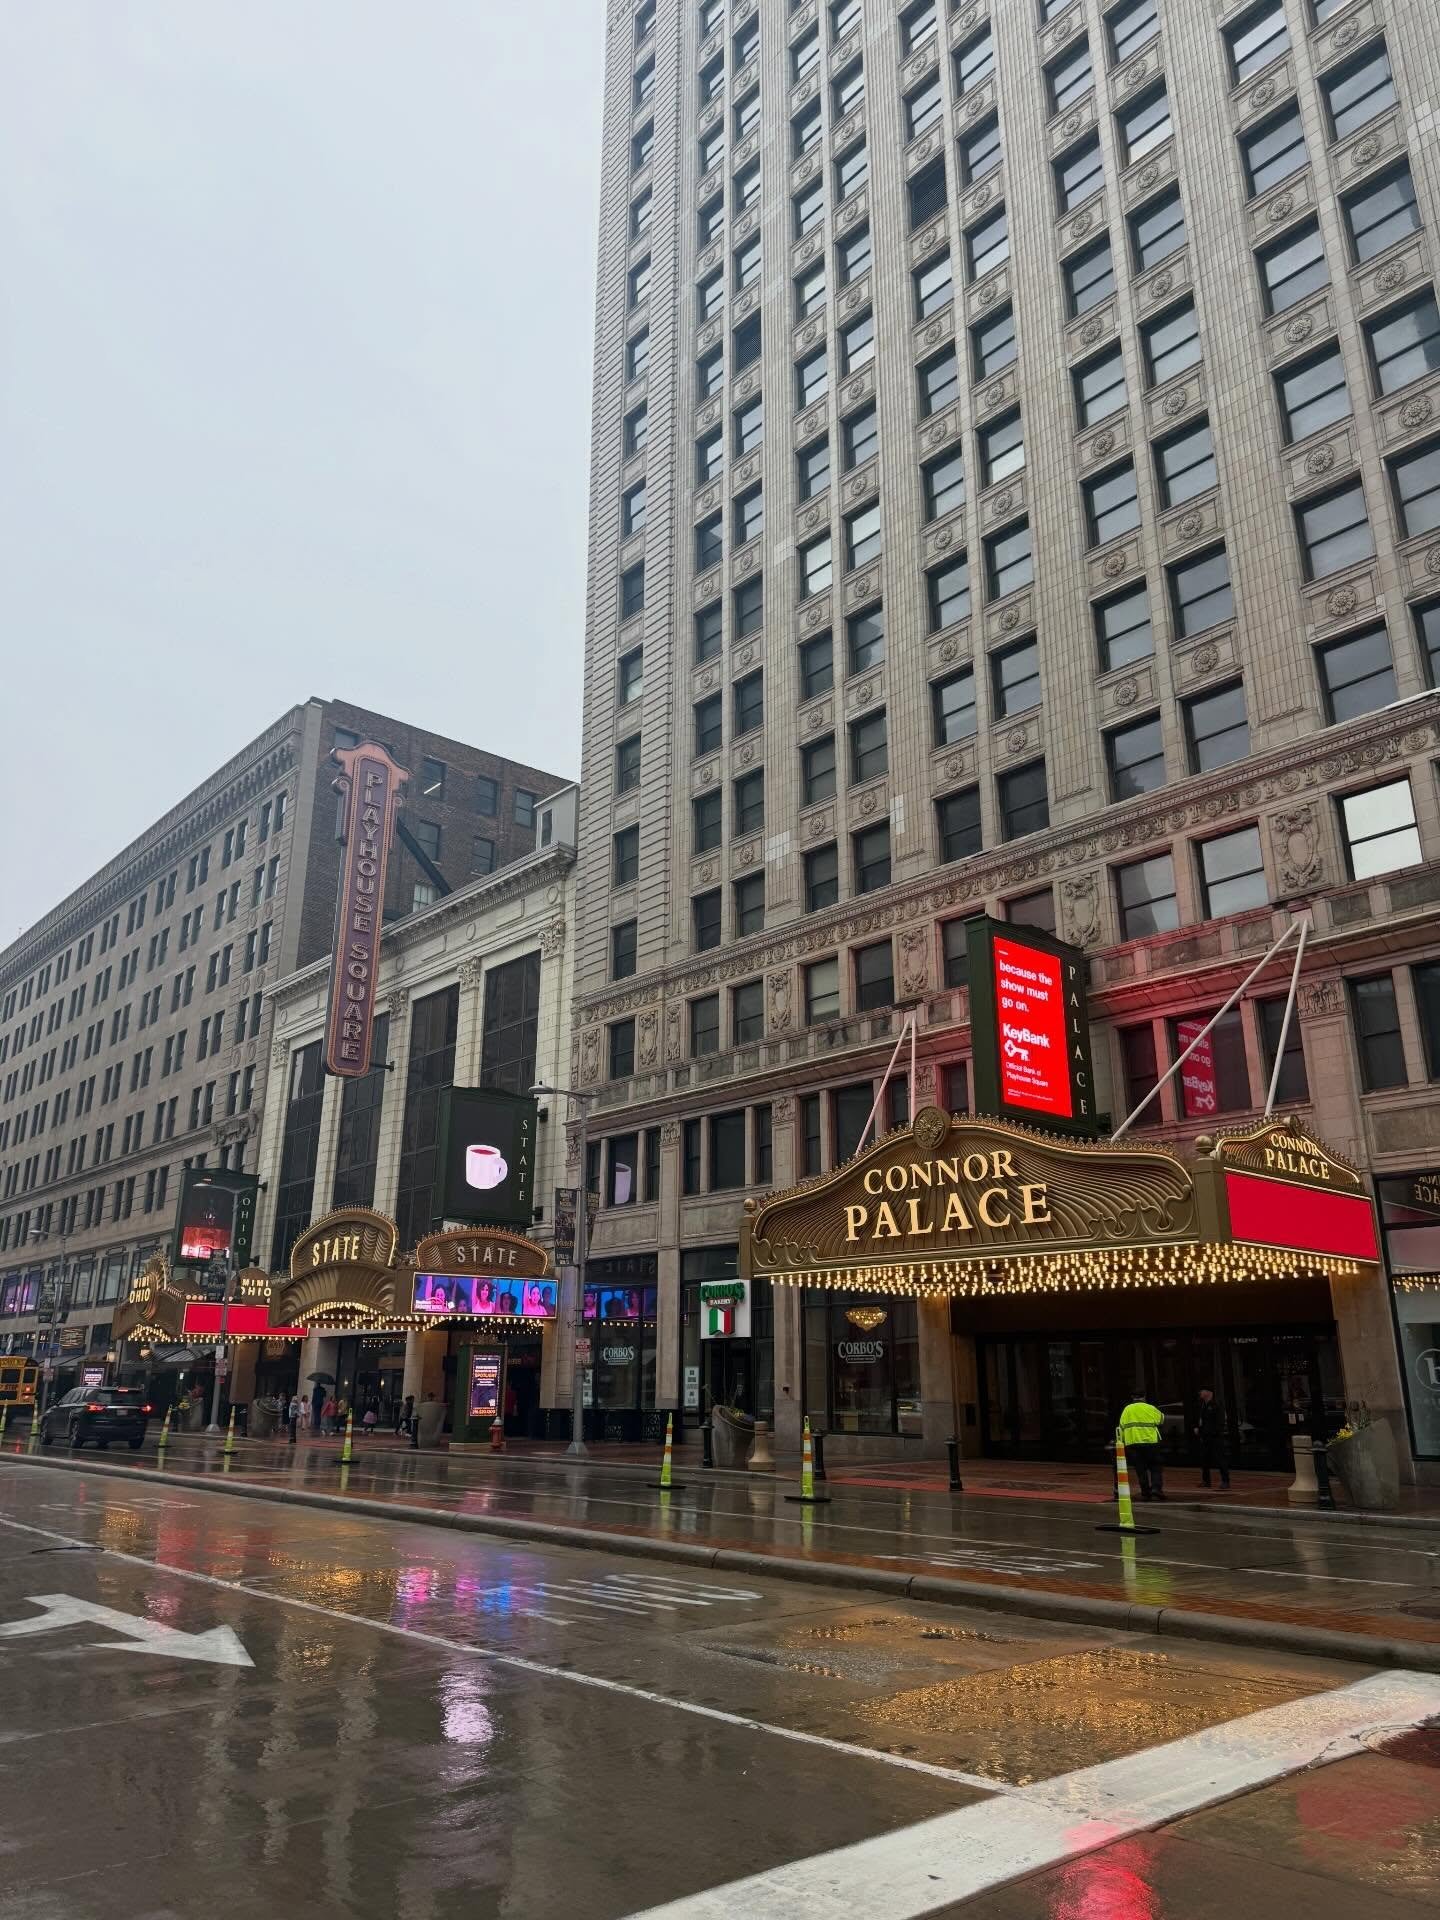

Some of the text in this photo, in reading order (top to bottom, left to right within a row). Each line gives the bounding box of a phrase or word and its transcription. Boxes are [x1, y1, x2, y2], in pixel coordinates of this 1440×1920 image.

[341, 770, 383, 1061] PLAYHOUSE SQUARE
[1000, 960, 1053, 986] because the
[1001, 978, 1049, 1002] show must
[1002, 996, 1030, 1013] go on.
[1002, 1022, 1050, 1048] KeyBank
[1068, 965, 1088, 1115] PALACE
[1270, 1133, 1320, 1157] CONNOR
[519, 1119, 529, 1201] STATE
[863, 1150, 1018, 1195] CONNOR
[1264, 1148, 1330, 1179] PALACE
[238, 1197, 251, 1246] OHIO
[843, 1183, 1052, 1242] PALACE
[312, 1235, 360, 1267] STATE
[457, 1245, 517, 1267] STATE
[133, 1276, 150, 1288] MIMI
[242, 1279, 269, 1287] MIMI
[699, 1283, 745, 1301] CORBO'S
[129, 1288, 151, 1304] OHIO
[603, 1345, 634, 1361] CORBO'S
[838, 1340, 883, 1359] CORBO'S
